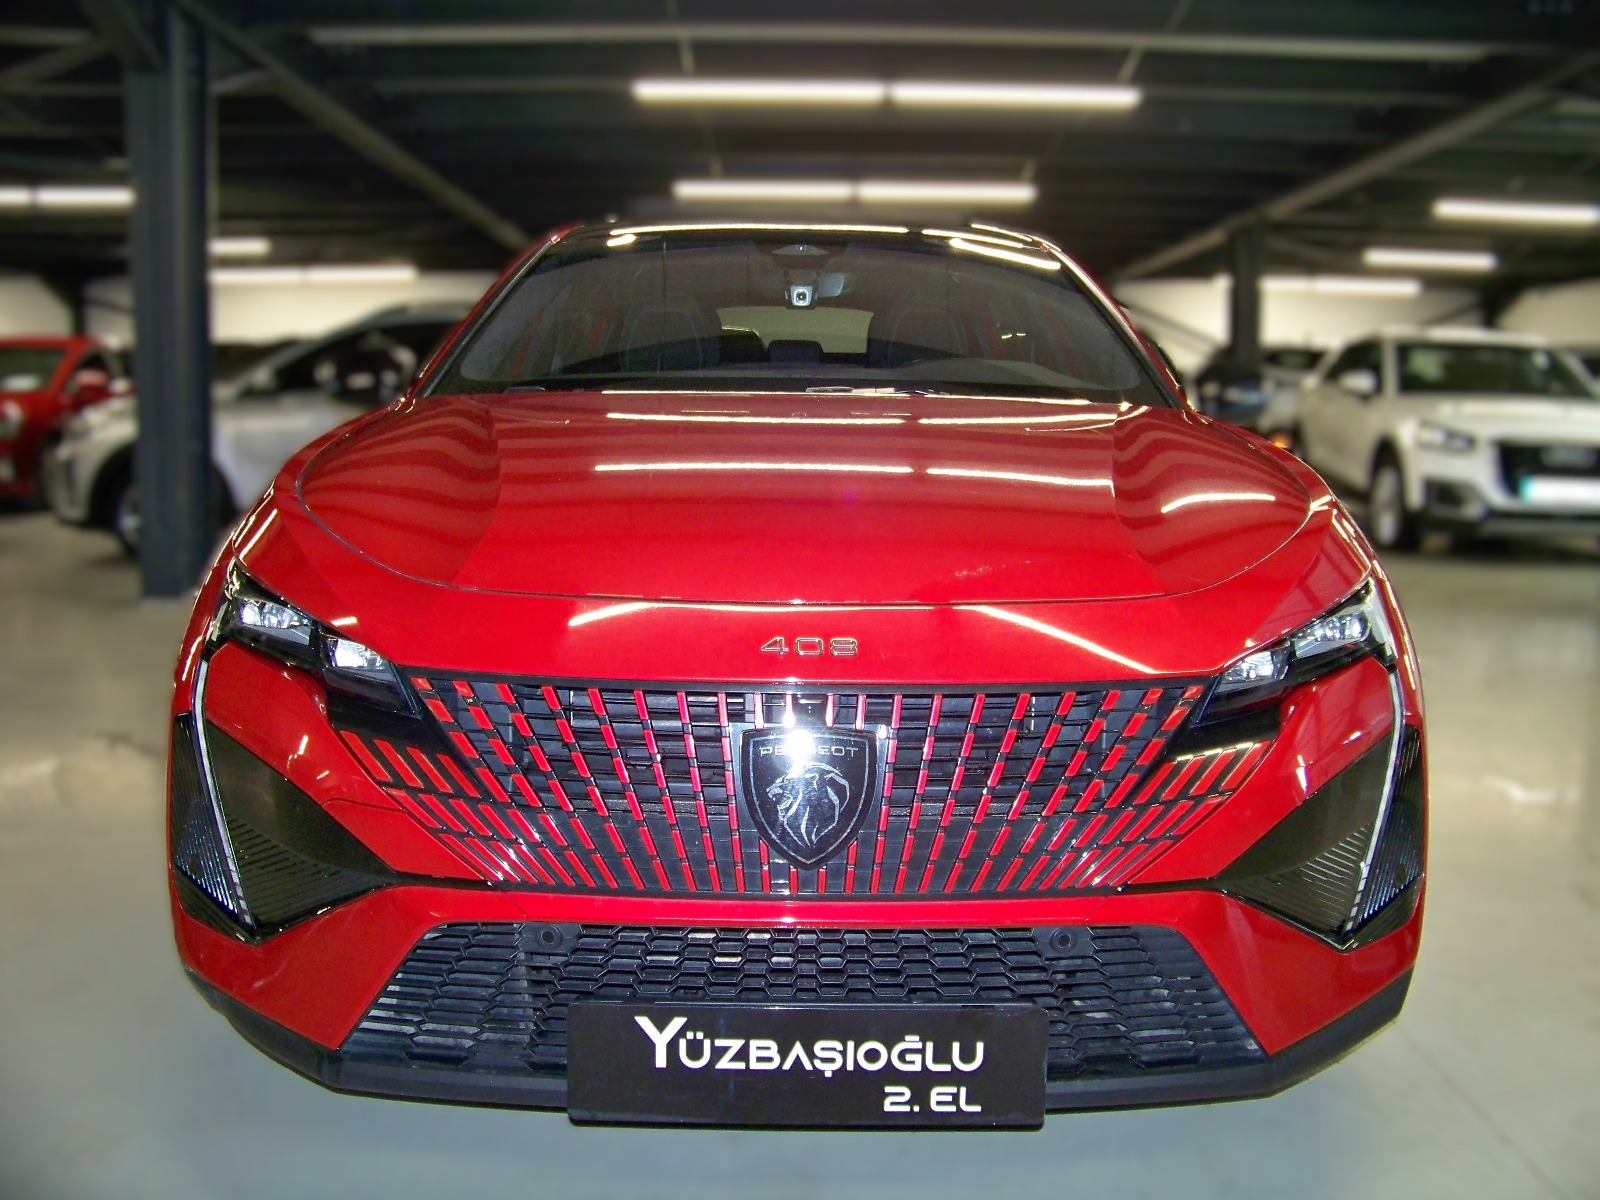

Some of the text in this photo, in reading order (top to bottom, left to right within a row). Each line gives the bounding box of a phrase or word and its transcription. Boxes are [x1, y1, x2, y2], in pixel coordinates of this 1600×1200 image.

[760, 636, 858, 656] 408
[758, 745, 859, 757] PEEOT
[634, 1016, 985, 1077] YÜZBAŞIOĞLU
[883, 1086, 982, 1113] 2. EL
